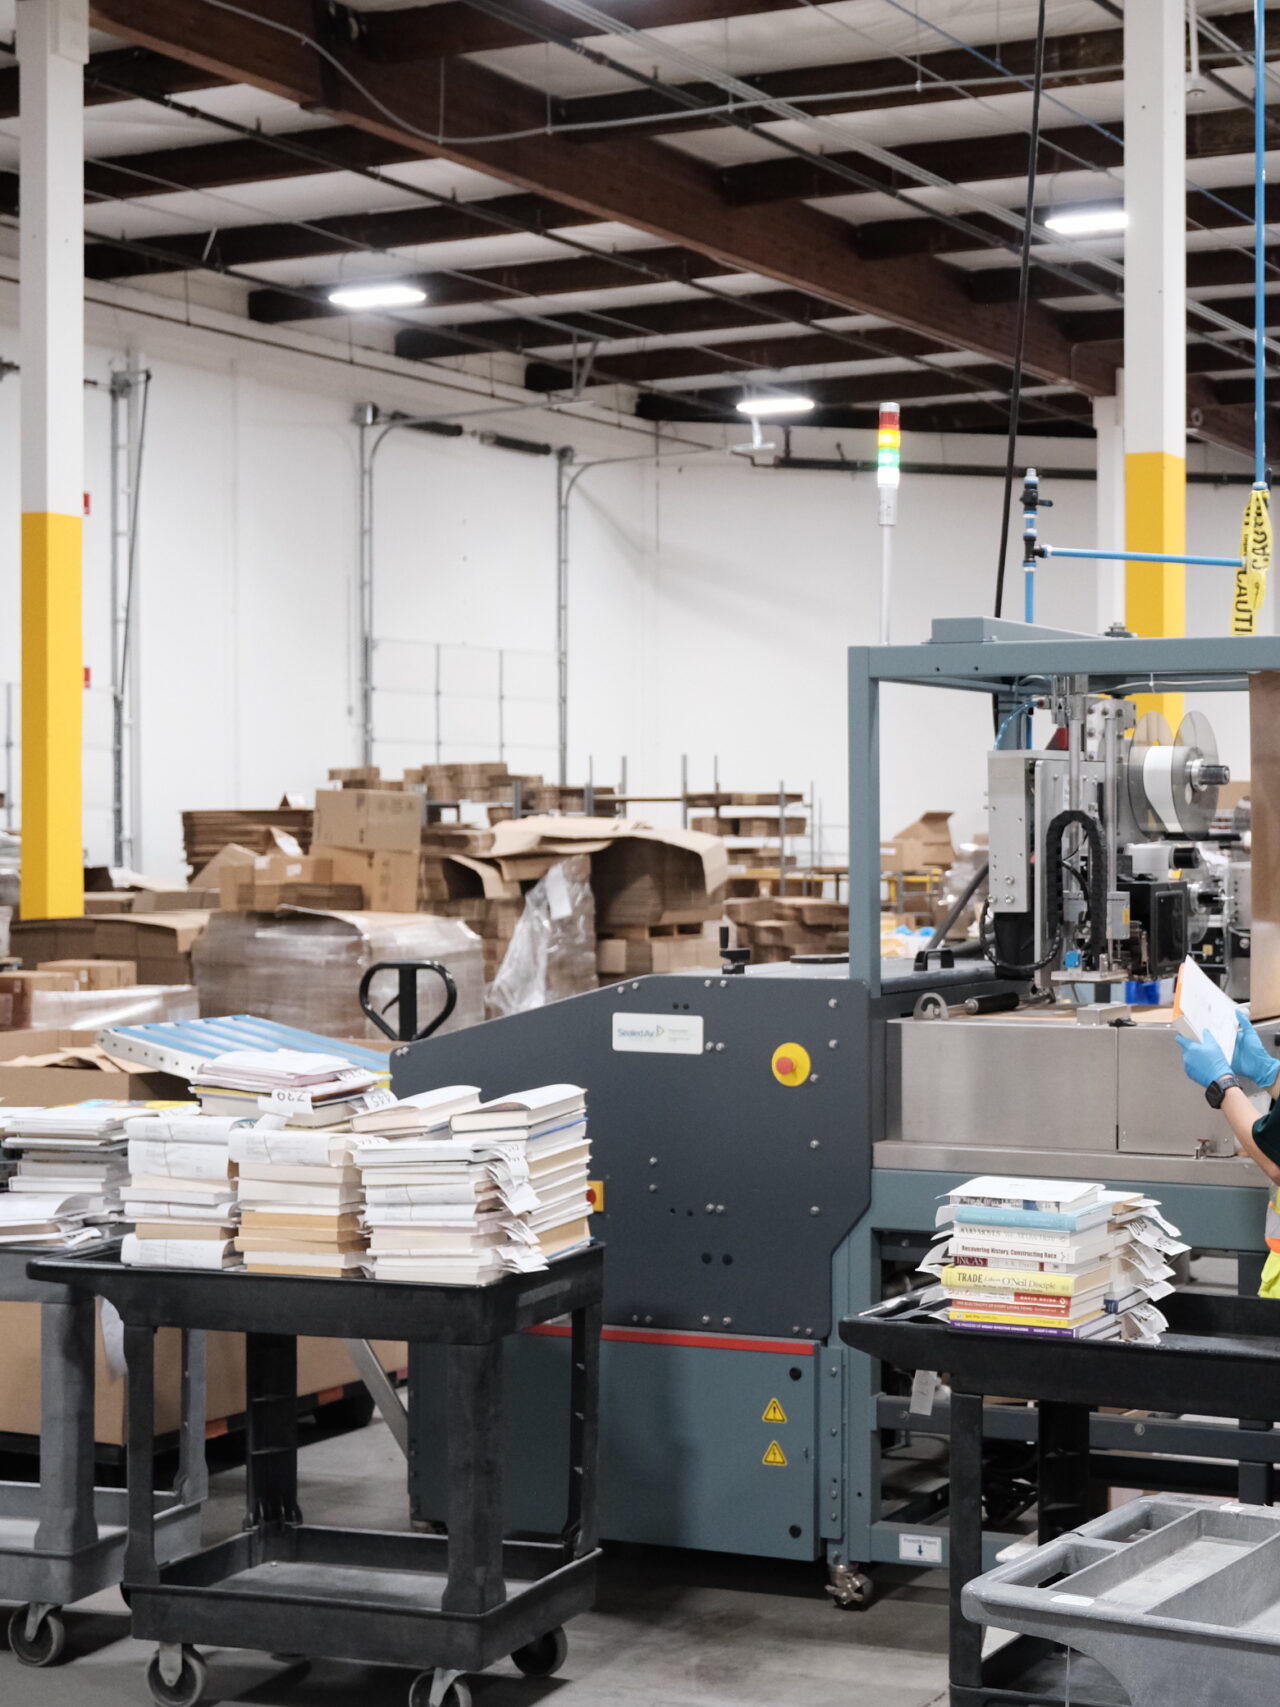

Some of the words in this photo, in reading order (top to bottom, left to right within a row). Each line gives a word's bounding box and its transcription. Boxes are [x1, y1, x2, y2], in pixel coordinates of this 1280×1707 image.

[962, 1245, 990, 1254] Recovering
[1010, 1248, 1044, 1258] Constructing
[1044, 1250, 1057, 1259] Race
[957, 1272, 983, 1283] TRADE
[1002, 1276, 1027, 1288] O'Neil
[1028, 1279, 1056, 1290] Disciple
